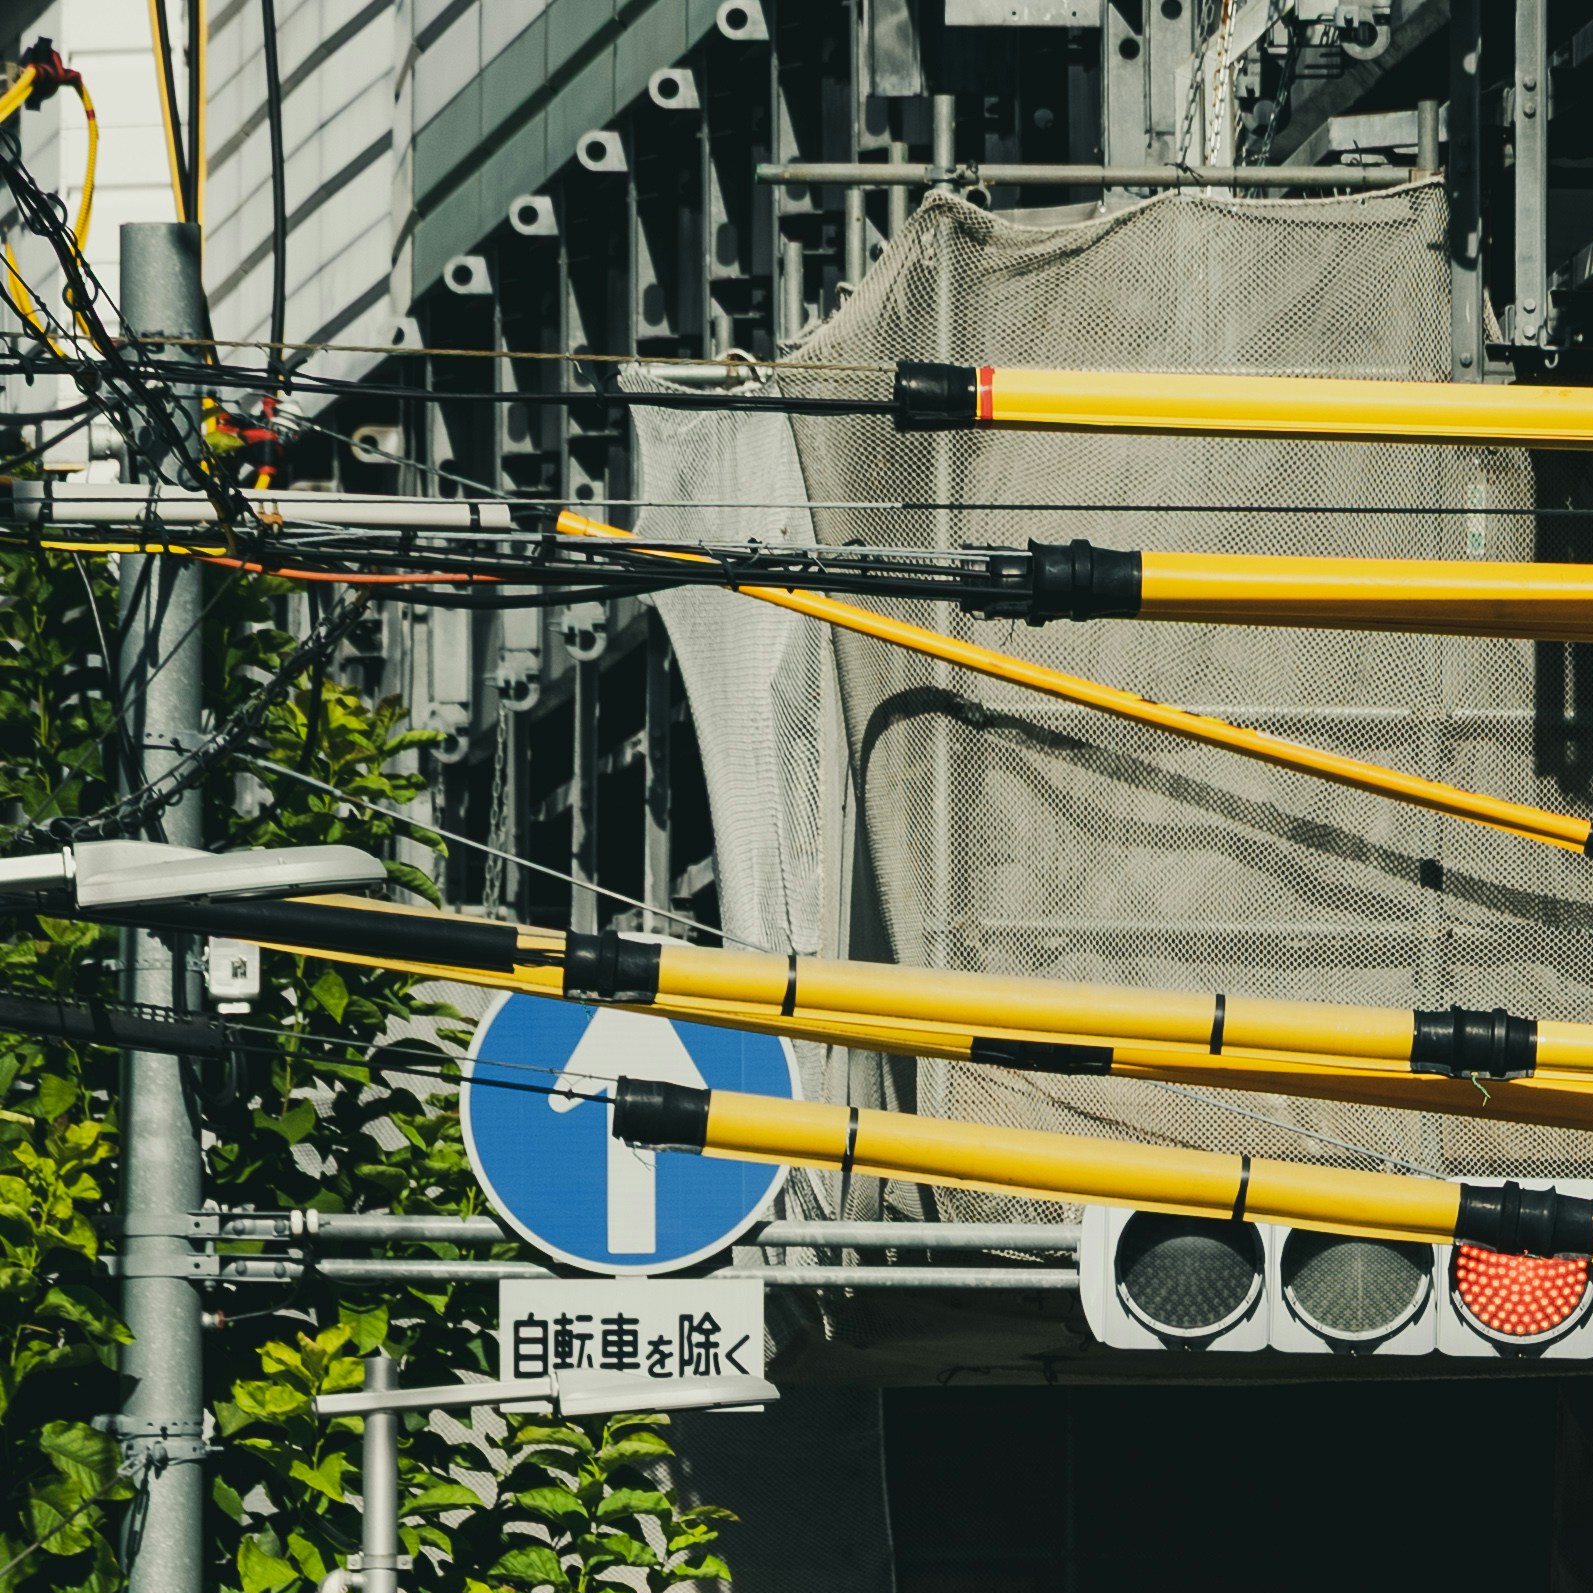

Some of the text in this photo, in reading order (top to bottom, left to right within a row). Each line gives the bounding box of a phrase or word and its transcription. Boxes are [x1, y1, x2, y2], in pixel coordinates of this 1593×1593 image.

[513, 1311, 750, 1379] 自転車を除く
